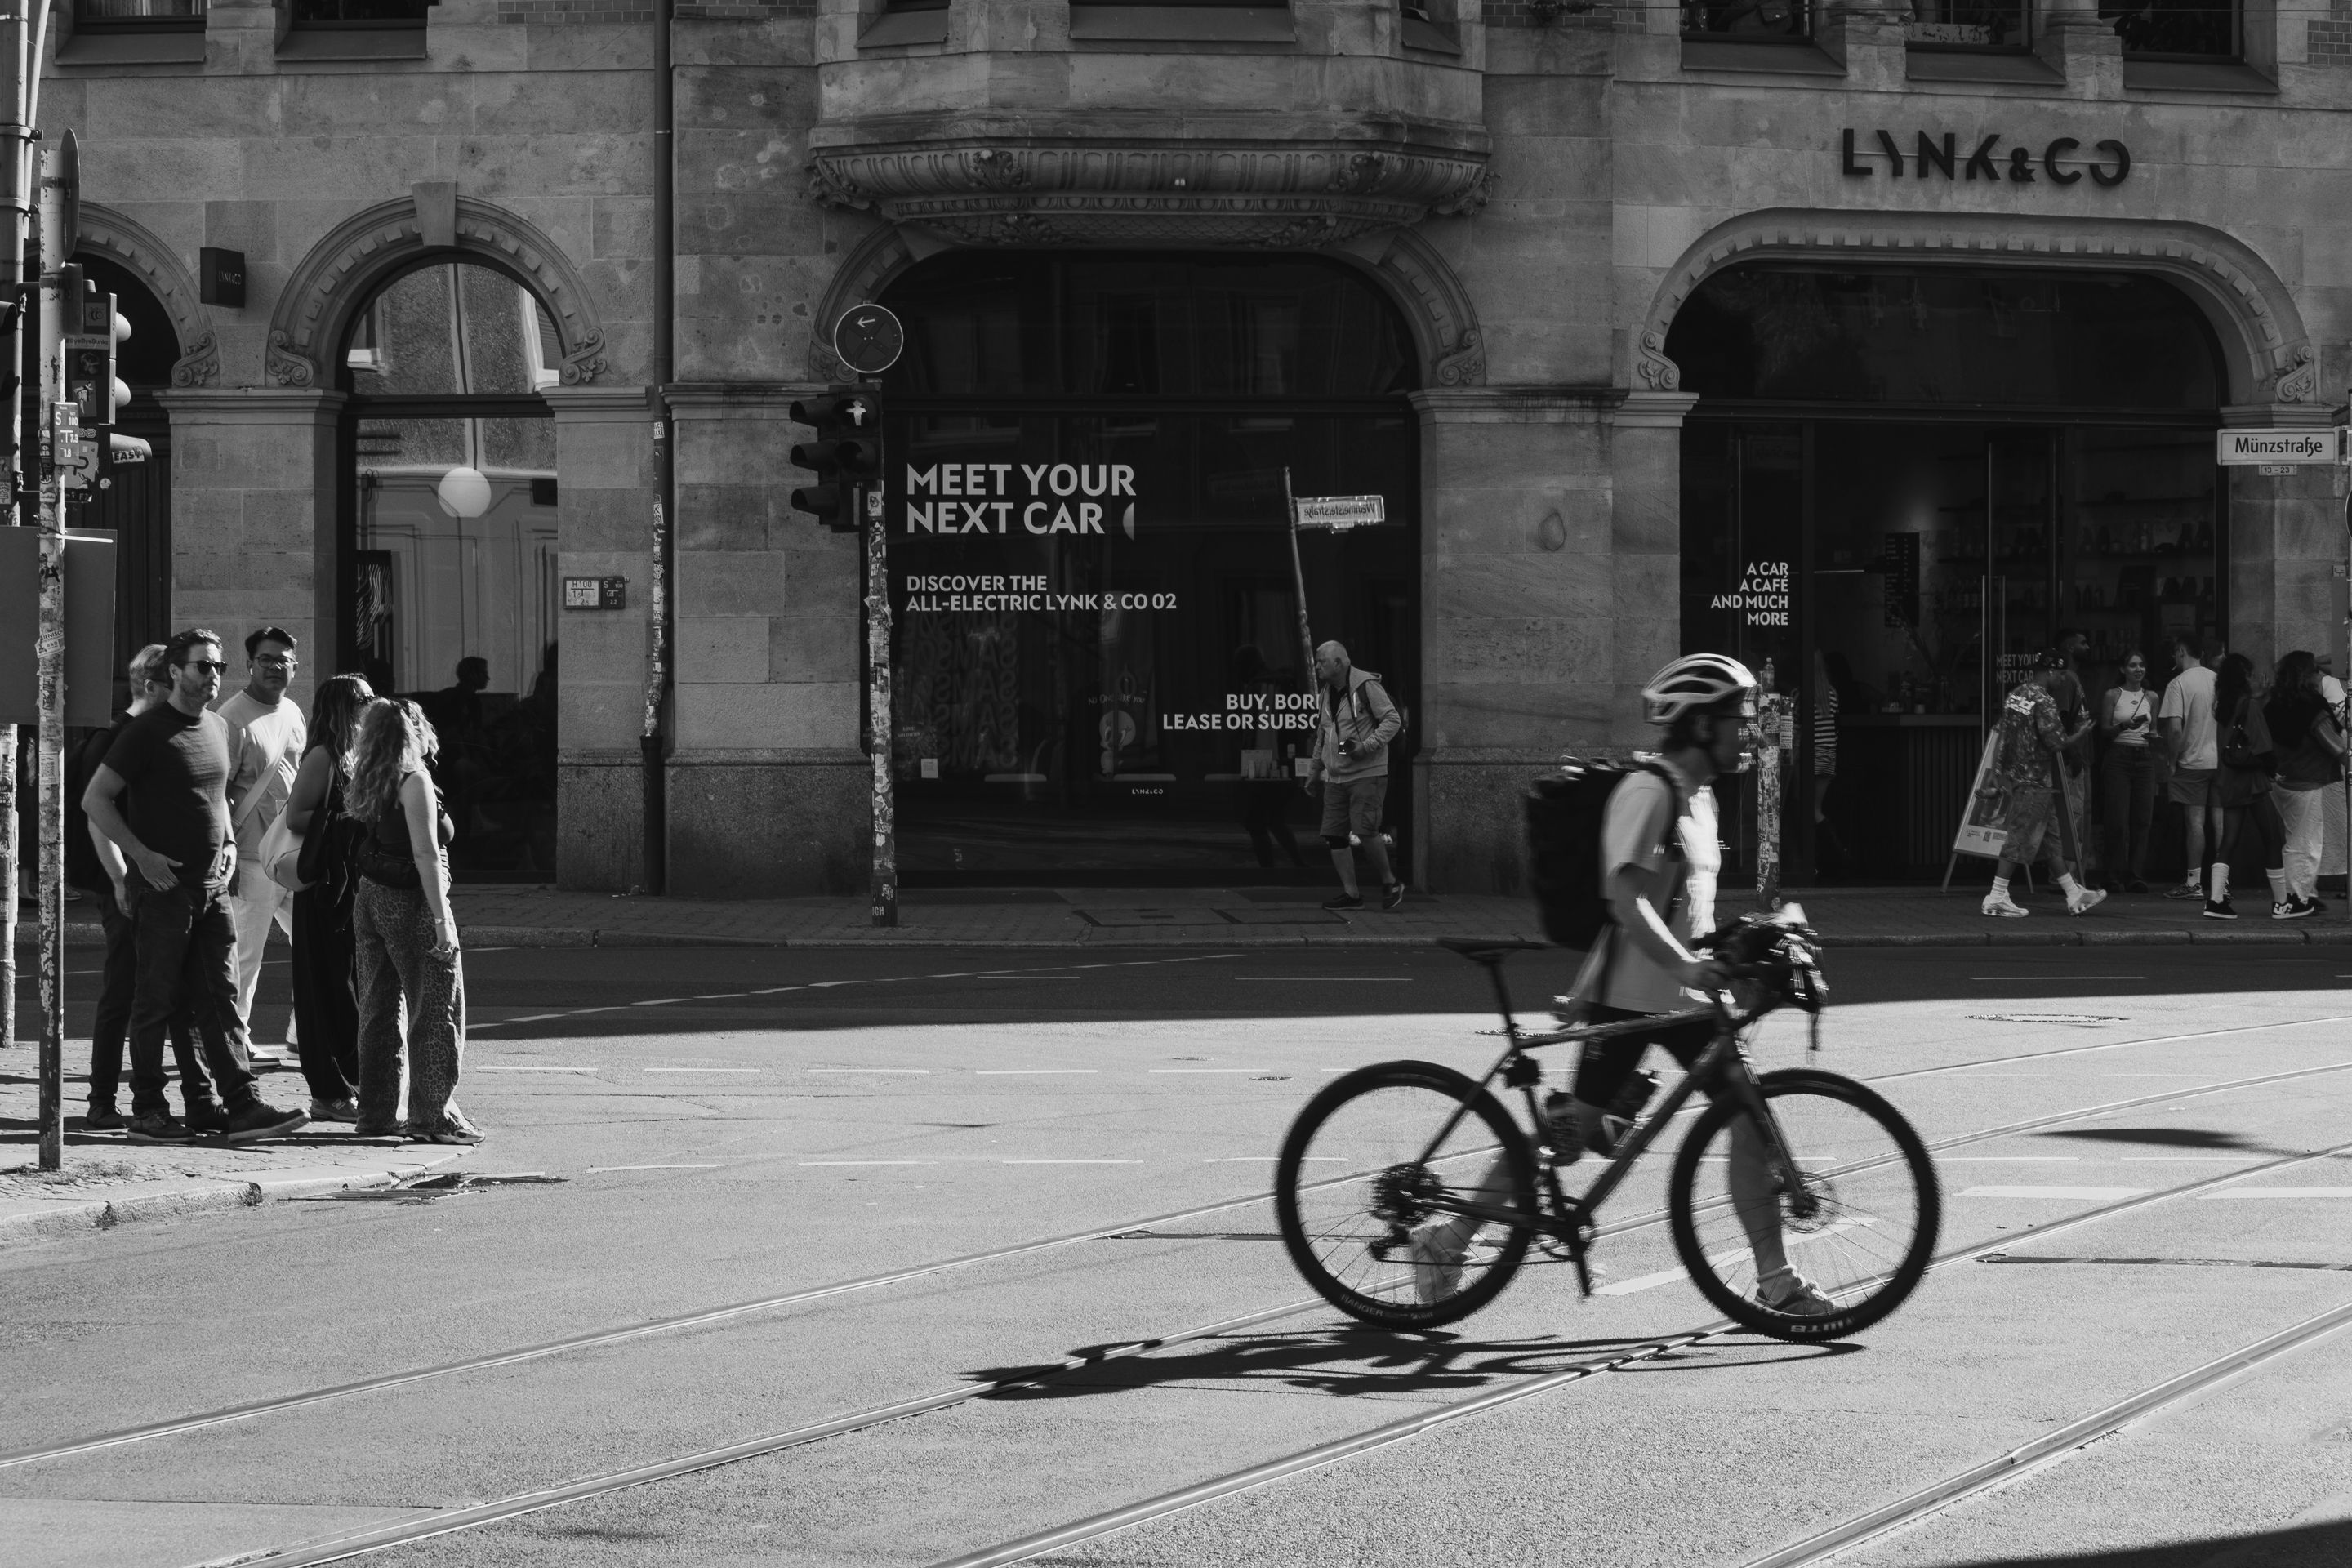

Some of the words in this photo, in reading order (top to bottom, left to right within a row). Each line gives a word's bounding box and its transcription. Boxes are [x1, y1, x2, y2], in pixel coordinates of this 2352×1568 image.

[2234, 436, 2323, 457] Münzstraße
[906, 463, 1012, 496] MEET
[1020, 463, 1137, 497] YOUR
[906, 501, 1014, 534] NEXT
[1023, 501, 1105, 535] CAR
[1746, 562, 1757, 576] A
[1759, 561, 1789, 577] CAR
[906, 575, 1005, 592] DISCOVER
[1009, 575, 1048, 592] THE
[1739, 578, 1750, 592] A
[1752, 574, 1788, 593] CAFÉ
[906, 594, 1042, 612] ALL-ELECTRIC
[1045, 594, 1099, 612] LYNK
[1103, 594, 1118, 611] &
[1120, 593, 1148, 611] CO
[1152, 593, 1177, 610] 02
[1710, 595, 1743, 608] AND
[1745, 595, 1788, 609] MUCH
[1747, 611, 1788, 626] MORE
[1996, 653, 2017, 666] MEET
[1996, 670, 2017, 684] NEXT
[1227, 693, 1270, 712] BUY,
[1163, 713, 1222, 730] LEASE
[1226, 713, 1254, 730] OR
[1340, 1293, 1392, 1317] RANGER
